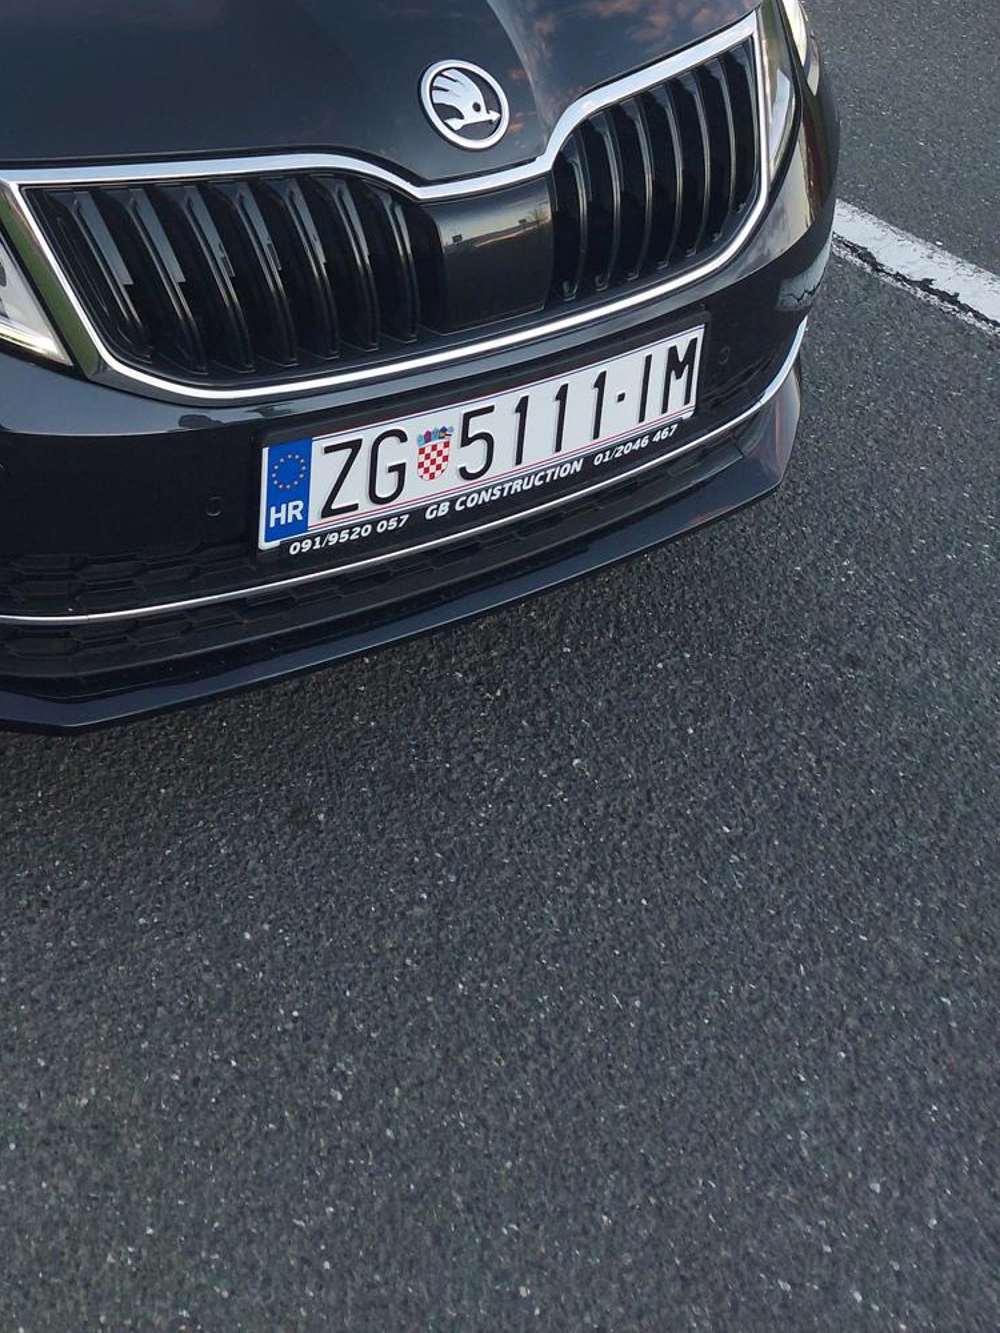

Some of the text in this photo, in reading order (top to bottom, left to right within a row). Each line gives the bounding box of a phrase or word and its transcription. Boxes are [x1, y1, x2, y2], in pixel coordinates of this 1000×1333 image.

[269, 500, 303, 528] HR
[288, 424, 678, 555] 091/9520 057 GB CONSTRUCTION 01/2046 467
[320, 428, 408, 519] ZG
